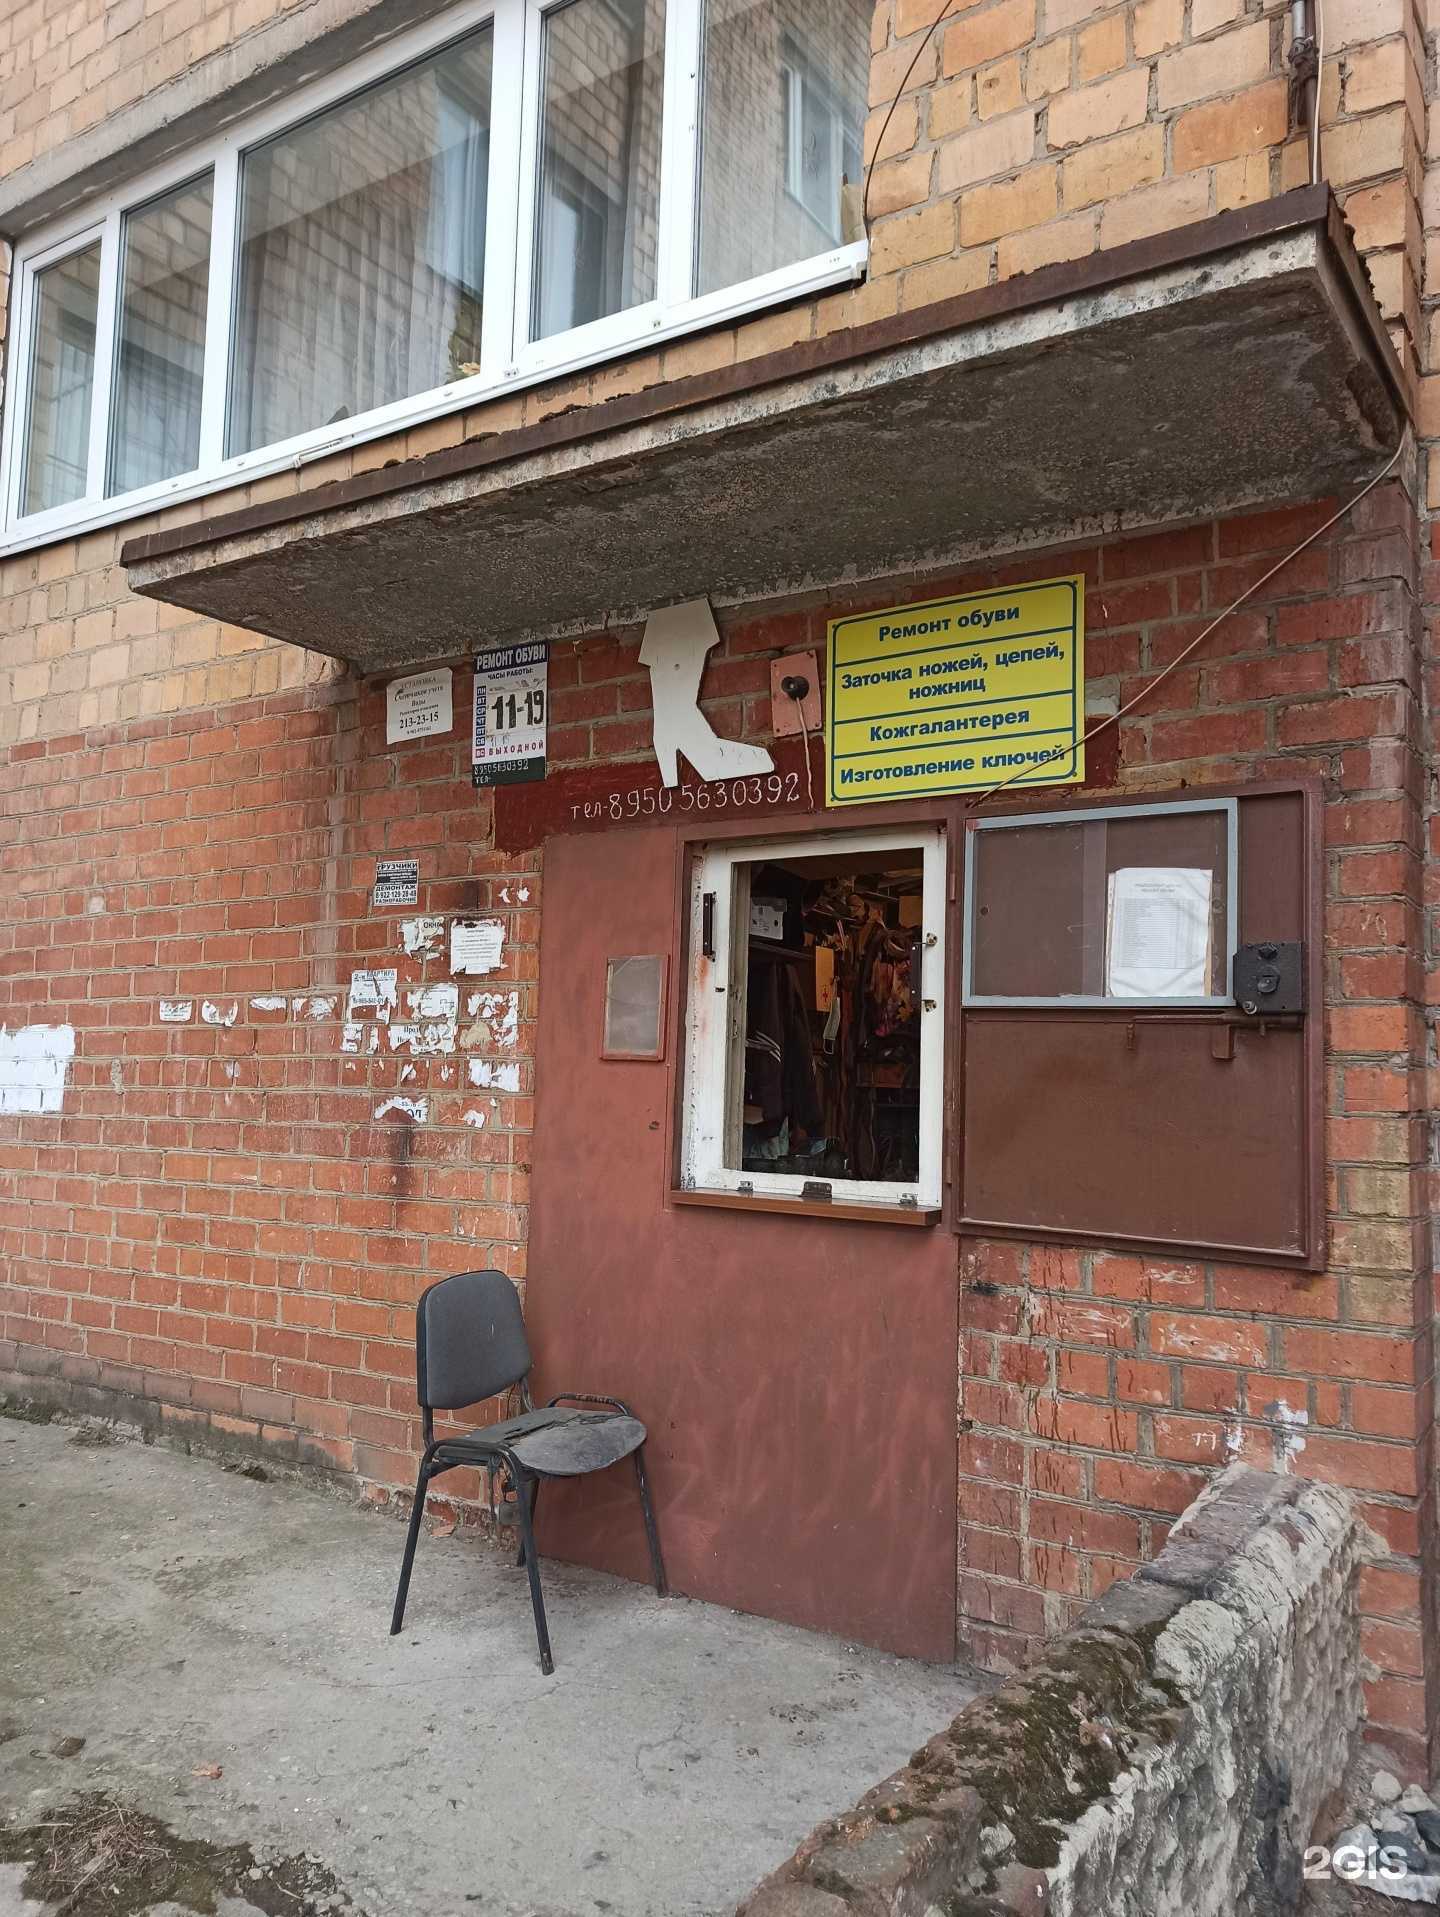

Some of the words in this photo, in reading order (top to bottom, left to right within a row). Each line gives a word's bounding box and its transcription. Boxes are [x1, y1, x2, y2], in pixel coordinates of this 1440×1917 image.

[879, 617, 951, 641] Ремонт
[957, 606, 1020, 629] обуви
[476, 649, 514, 671] РЕМОНТ
[515, 644, 546, 664] ОБУВИ
[841, 666, 913, 689] Заточка
[919, 653, 989, 677] ножей,
[995, 641, 1065, 668] цепей,
[487, 672, 506, 681] ЧАСЫ
[909, 676, 986, 700] ножниц
[399, 711, 439, 729] 213-23-15
[491, 690, 545, 730] 11-19
[870, 707, 1030, 742] Кожгалантерея
[488, 740, 544, 756] ВЫХОДНОЙ
[840, 756, 975, 785] Изготовление
[982, 745, 1065, 770] ключей
